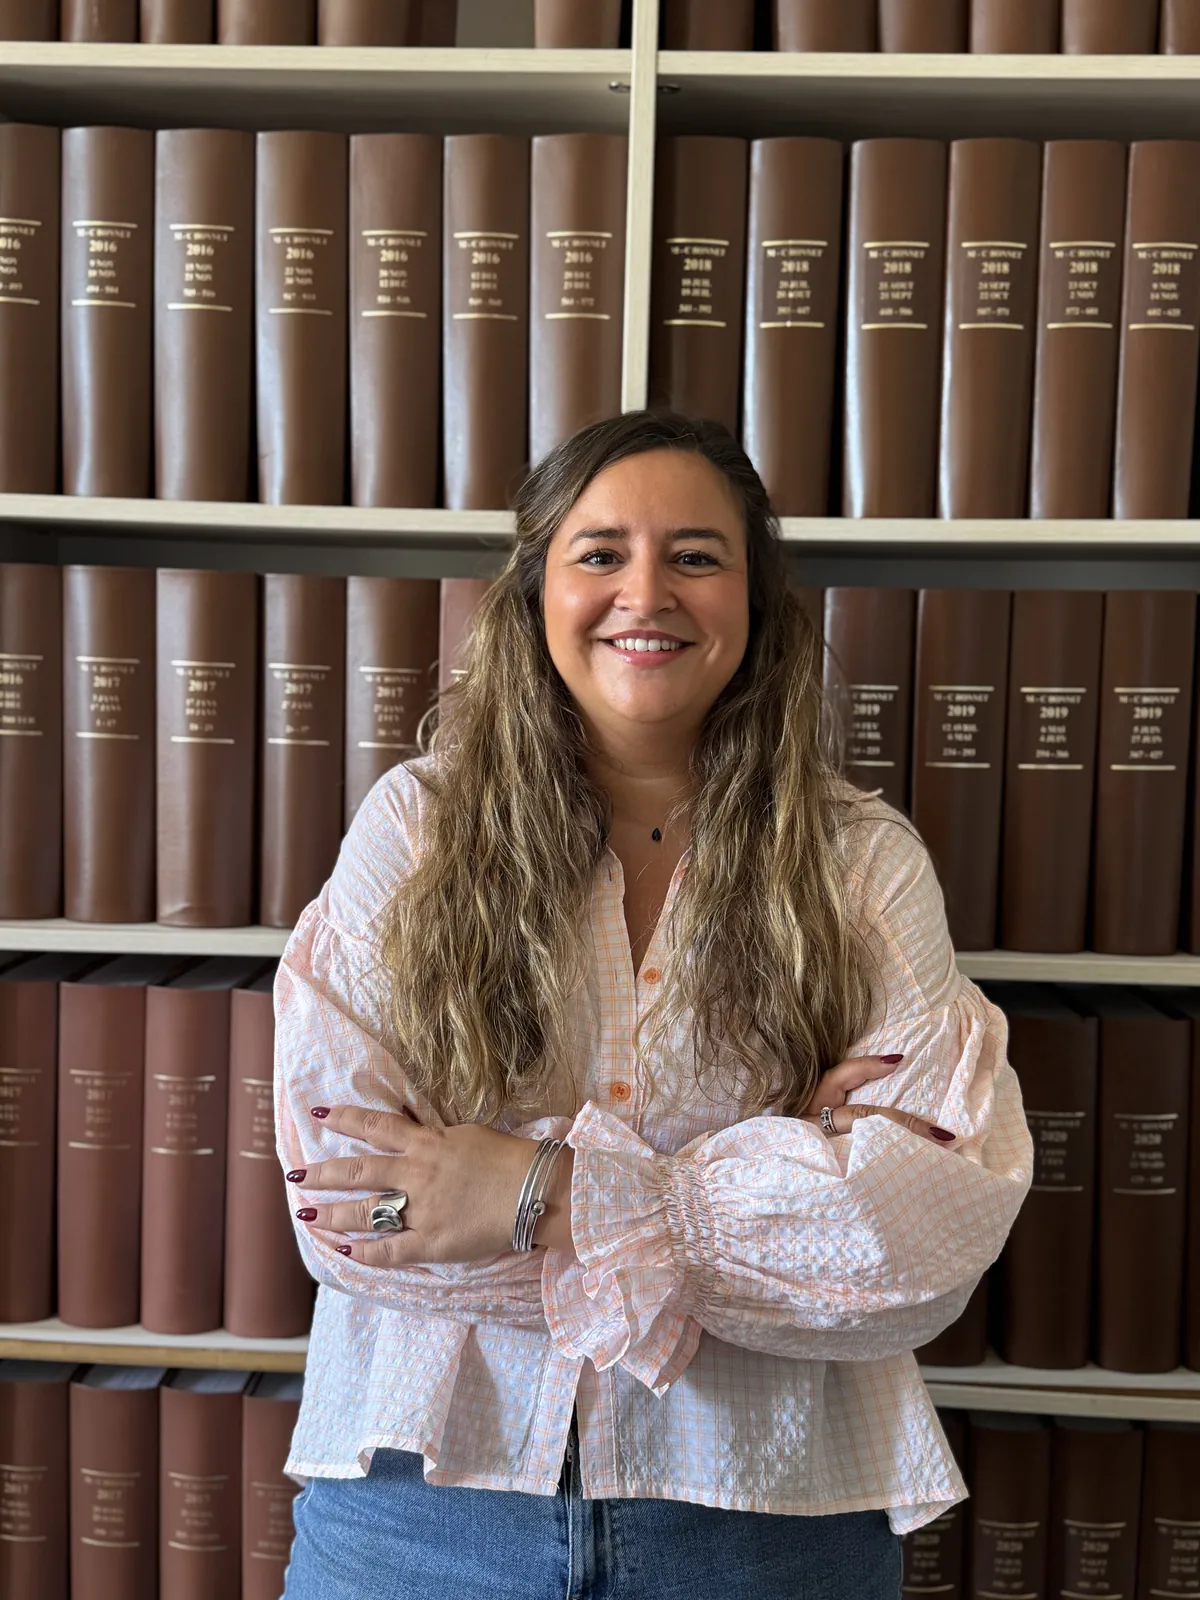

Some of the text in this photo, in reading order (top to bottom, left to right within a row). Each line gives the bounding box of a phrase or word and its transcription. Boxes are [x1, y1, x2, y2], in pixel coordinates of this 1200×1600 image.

[0, 237, 21, 250] 016
[89, 240, 117, 252] 2016
[186, 243, 214, 256] 2016
[285, 247, 314, 260] 2016
[380, 249, 408, 262] 2016
[471, 252, 500, 264] 2016
[564, 251, 593, 264] 2016
[684, 258, 712, 271] 2018
[781, 261, 809, 273] 2018
[883, 261, 911, 274] 2018
[981, 262, 1010, 274] 2018
[1069, 262, 1098, 274] 2018
[1152, 263, 1181, 275] 2018
[93, 675, 121, 688] 2017
[188, 680, 216, 691] 2017
[284, 682, 312, 695] 2017
[376, 686, 404, 698] 2017
[853, 703, 881, 716] 2019
[947, 705, 976, 717] 2019
[1040, 707, 1069, 719] 2019
[1133, 707, 1162, 719] 2019
[1134, 1134, 1161, 1145] 2020
